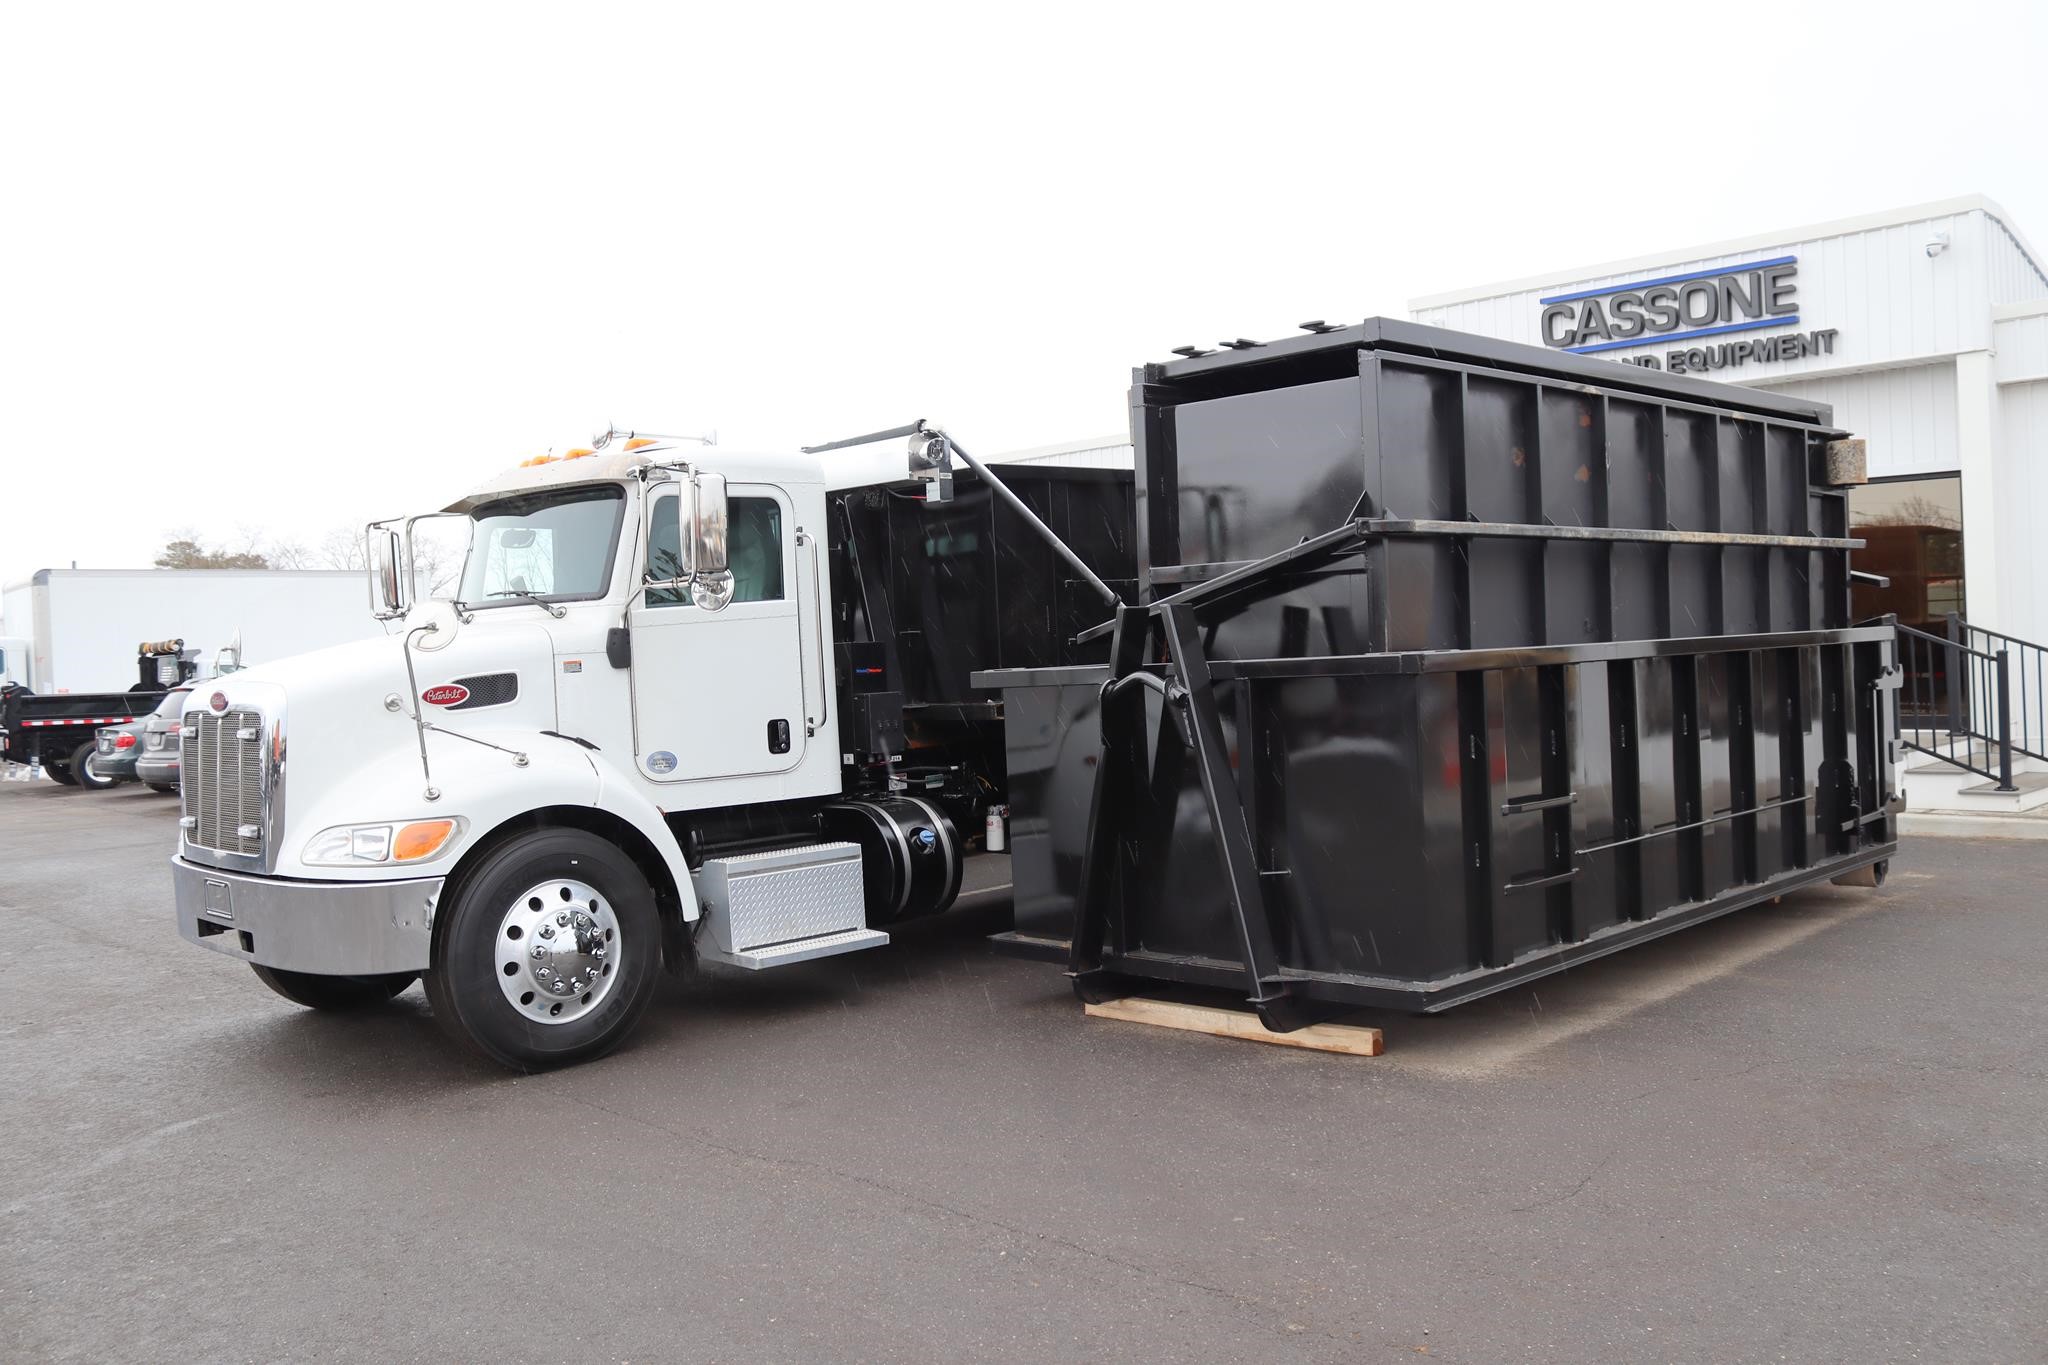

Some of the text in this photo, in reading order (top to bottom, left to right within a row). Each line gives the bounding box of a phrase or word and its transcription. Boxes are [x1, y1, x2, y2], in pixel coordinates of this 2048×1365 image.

[1541, 264, 1799, 347] CASSONE
[1667, 328, 1838, 374] EQUIPMENT
[427, 688, 464, 702] Peterbilt
